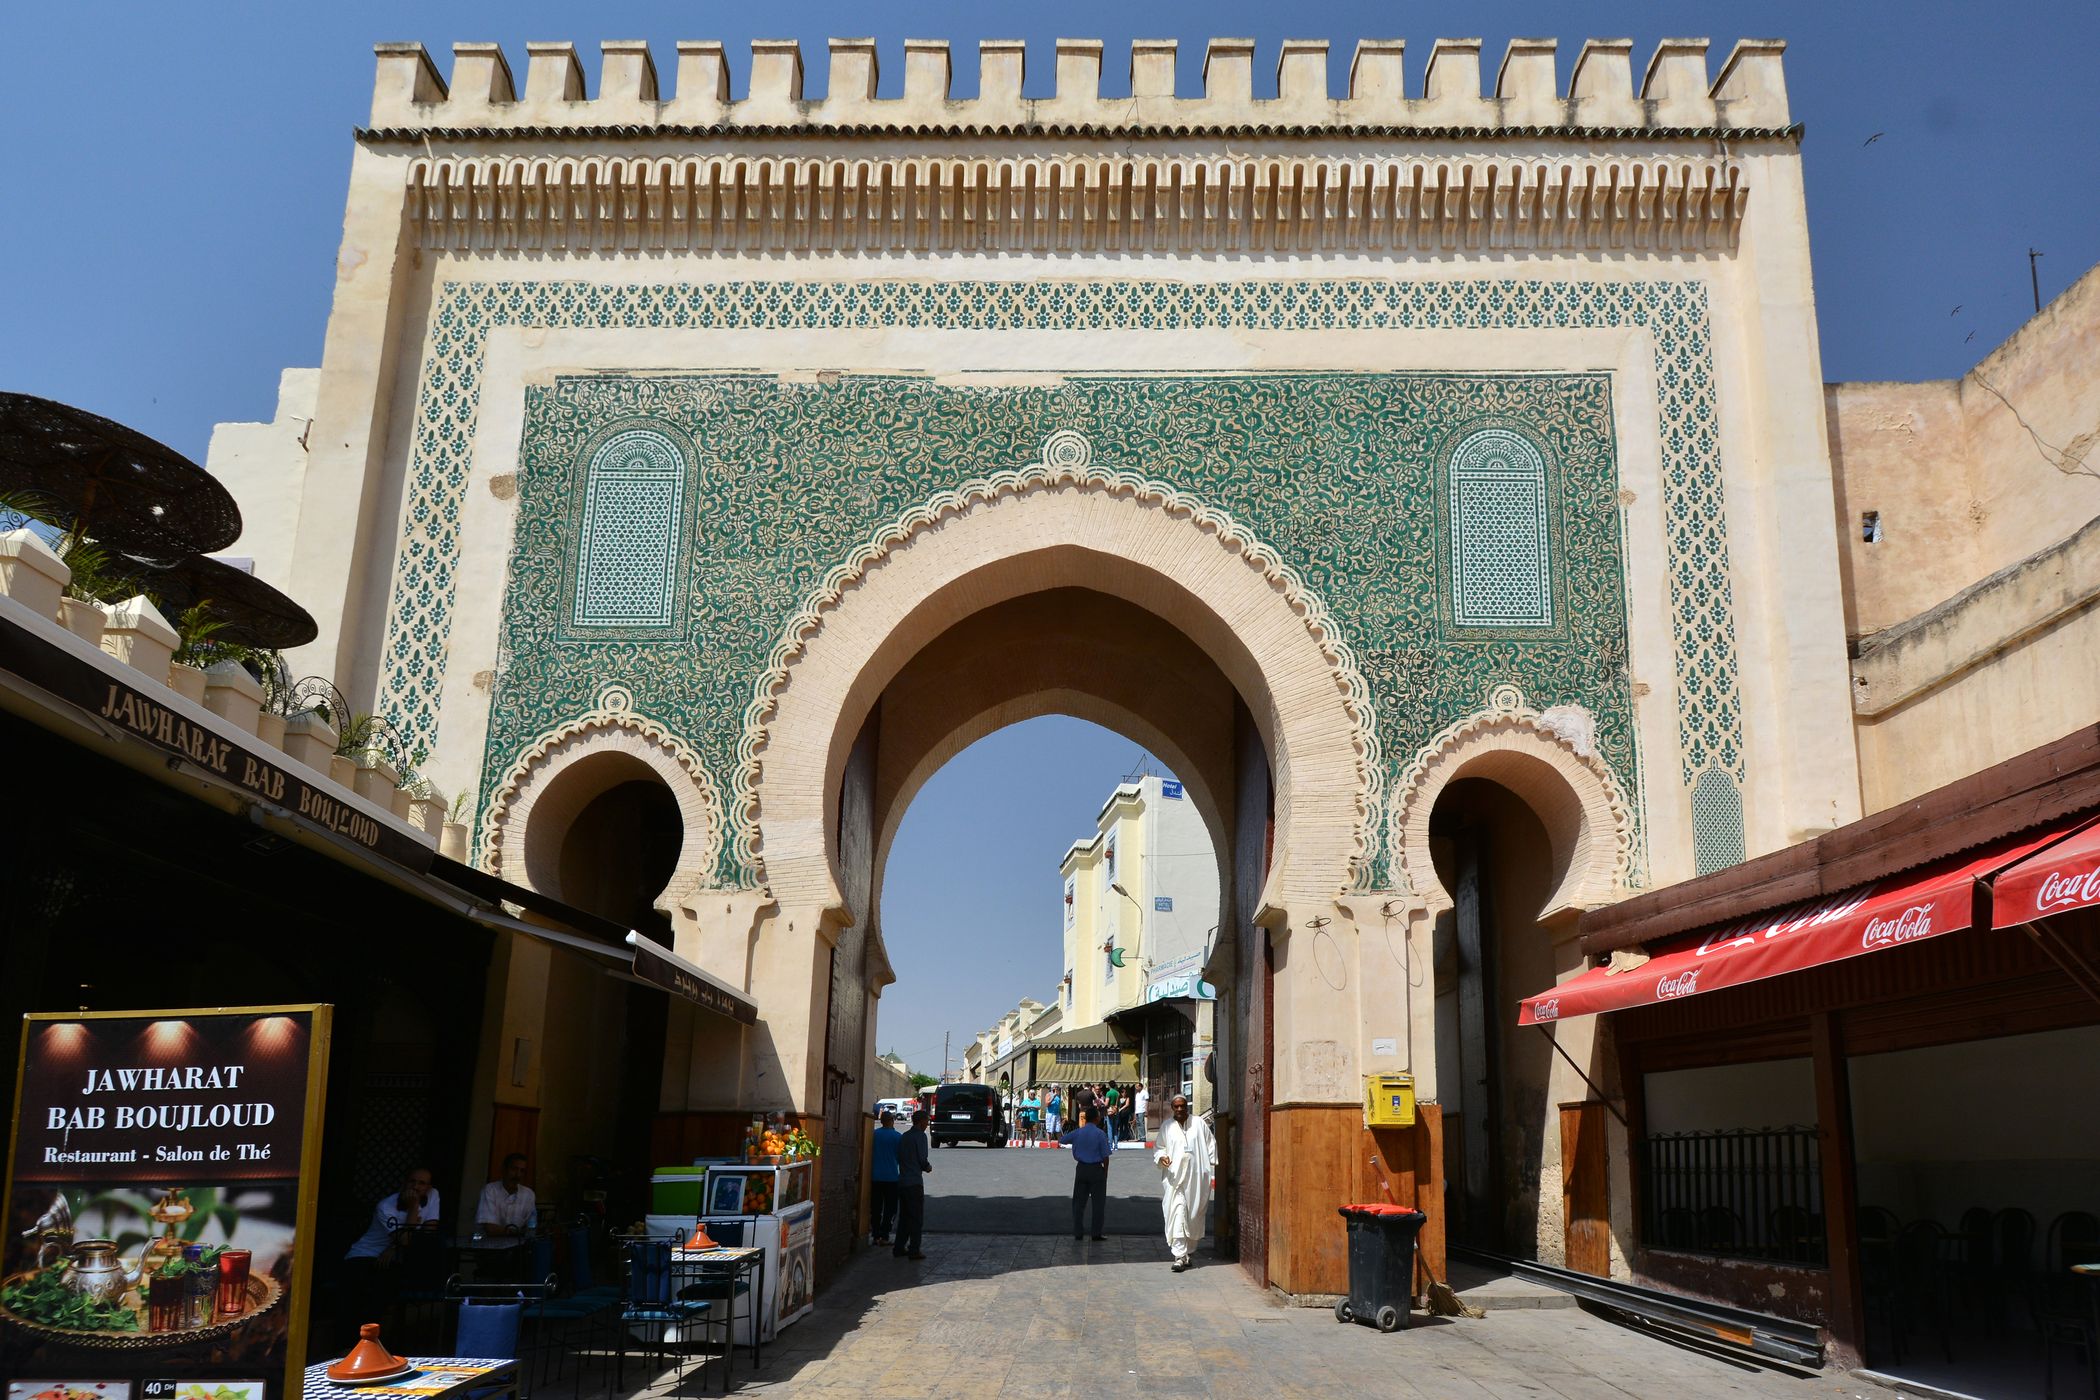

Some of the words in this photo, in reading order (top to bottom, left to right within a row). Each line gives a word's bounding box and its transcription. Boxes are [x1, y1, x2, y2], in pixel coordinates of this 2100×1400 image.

[101, 685, 233, 773] JAWHARAT
[242, 757, 285, 800] BAB
[299, 785, 380, 848] BOUJLOUD
[1862, 901, 1936, 949] Coca-Cola
[1656, 967, 1703, 1000] Coca-Cola
[1534, 998, 1560, 1021] Coca-Cola
[82, 1065, 244, 1095] JAWHARAT
[46, 1106, 106, 1130] BAB
[114, 1103, 275, 1131] BOUJLOUD
[43, 1147, 137, 1163] Restaurant
[155, 1145, 204, 1162] Salon
[209, 1146, 231, 1161] de
[237, 1143, 271, 1160] Thé
[145, 1383, 161, 1395] 40
[164, 1383, 175, 1391] DH
